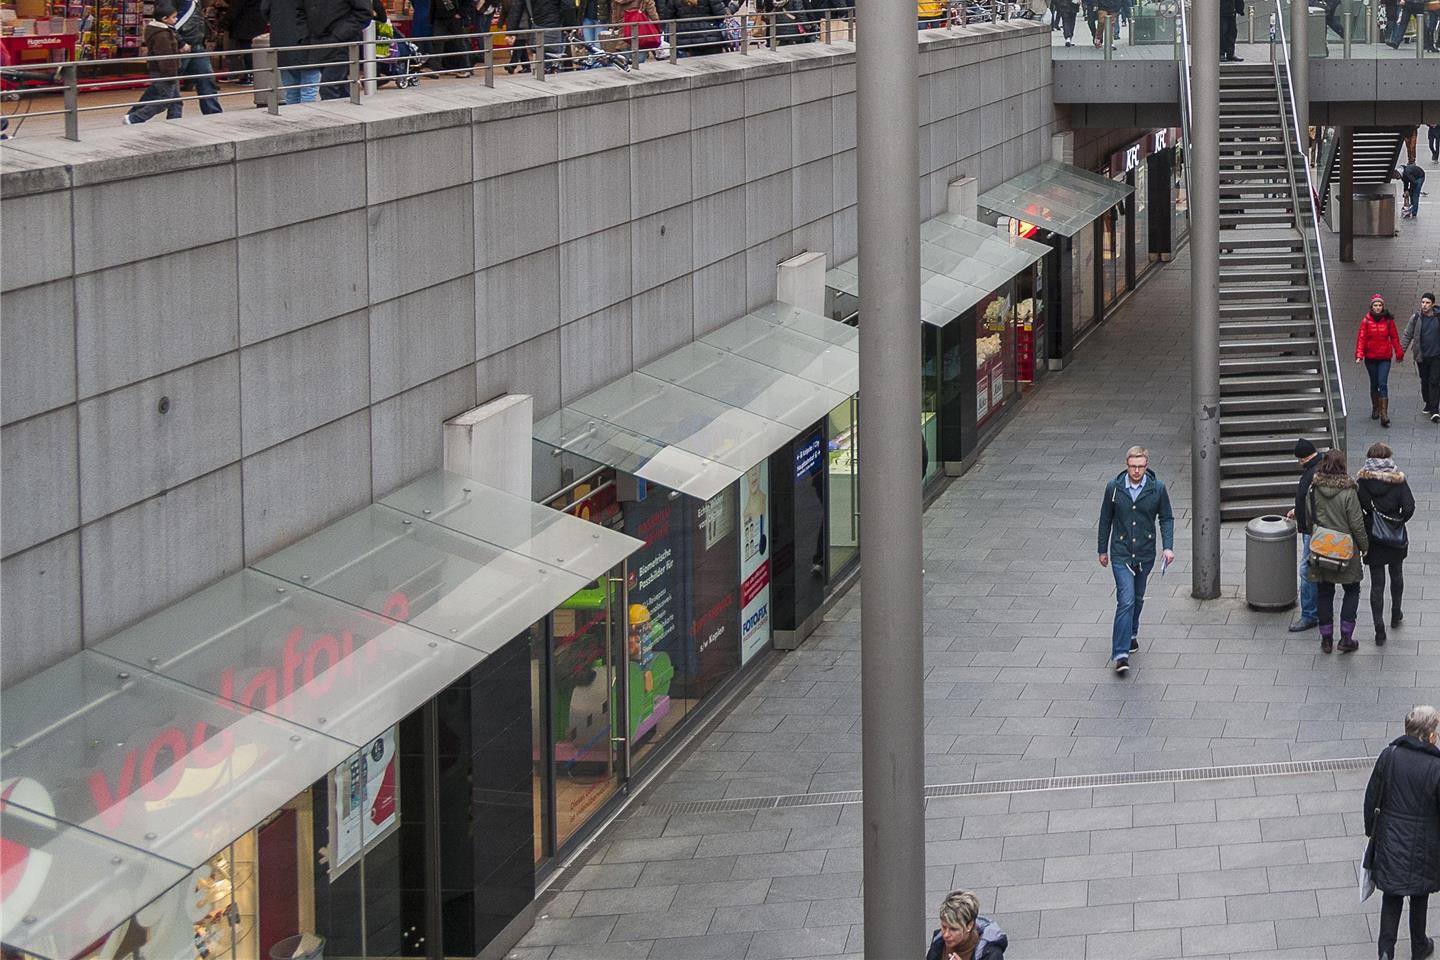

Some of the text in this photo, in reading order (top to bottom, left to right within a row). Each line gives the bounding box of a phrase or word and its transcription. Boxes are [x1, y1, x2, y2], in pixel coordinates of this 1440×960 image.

[1125, 143, 1140, 172] KFC
[639, 548, 671, 577] Biometrische
[639, 566, 666, 591] Passbilder
